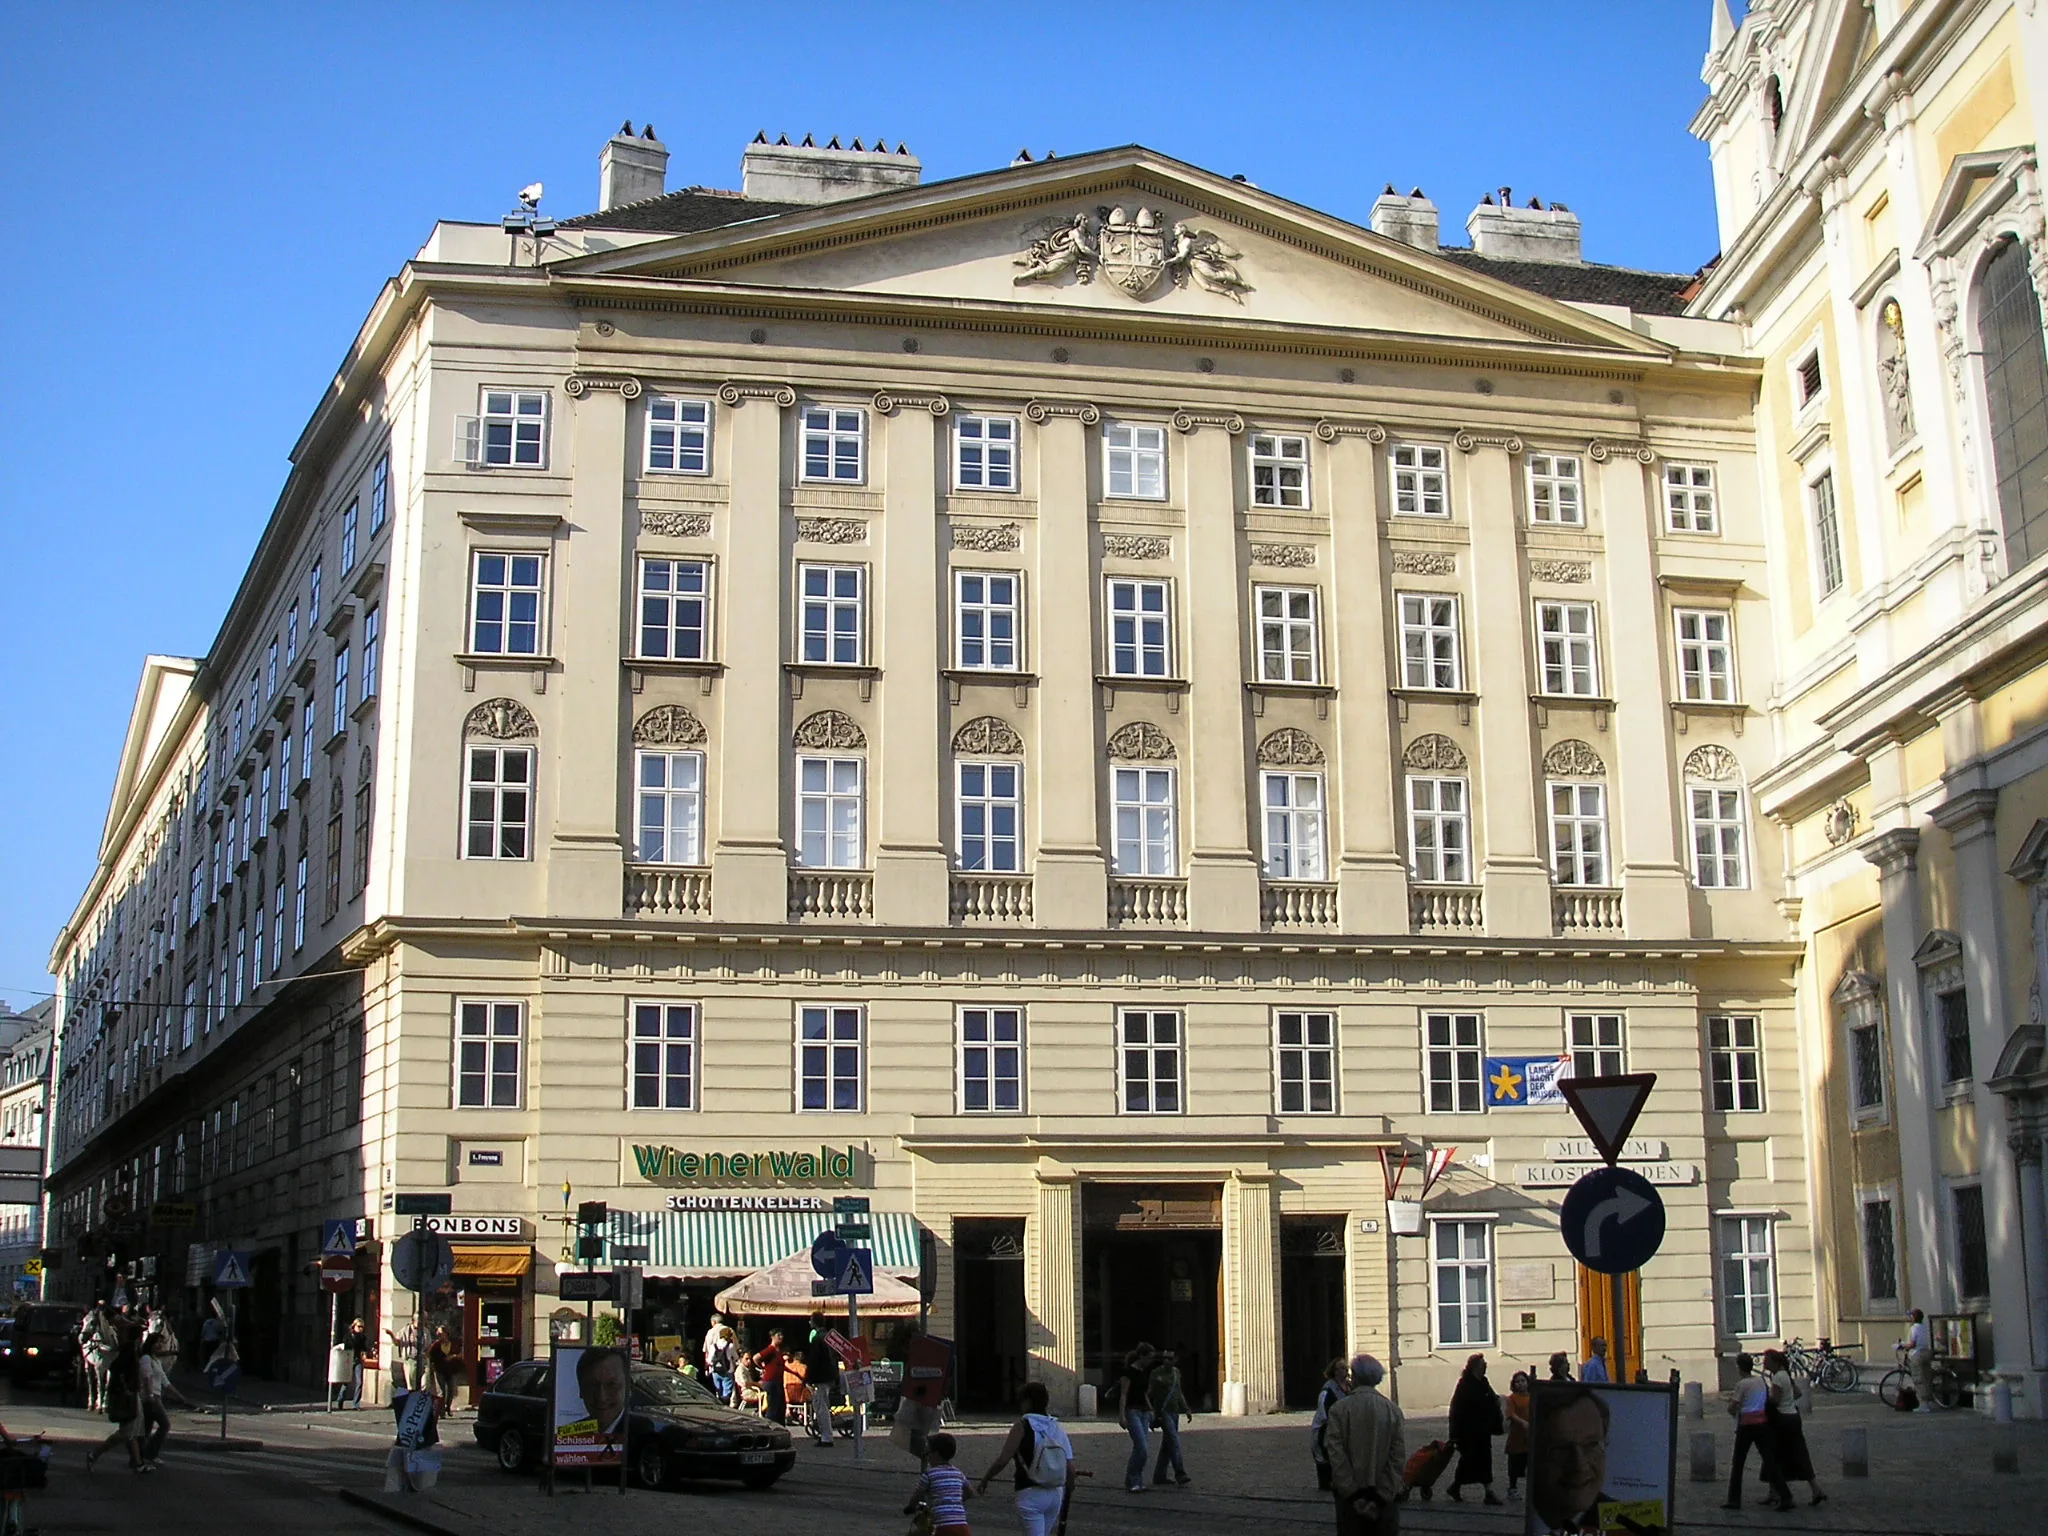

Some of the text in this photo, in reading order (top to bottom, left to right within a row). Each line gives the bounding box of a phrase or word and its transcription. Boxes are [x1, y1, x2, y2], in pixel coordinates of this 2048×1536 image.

[1529, 1066, 1554, 1074] LANGE
[1530, 1074, 1554, 1082] NACHT
[632, 1144, 855, 1178] Wienerwald
[666, 1195, 822, 1210] SCHOTTENKELLER
[414, 1219, 519, 1233] BONBONS
[406, 1391, 430, 1427] Presse
[556, 1435, 595, 1445] Schüssel
[556, 1454, 589, 1463] wählen.
